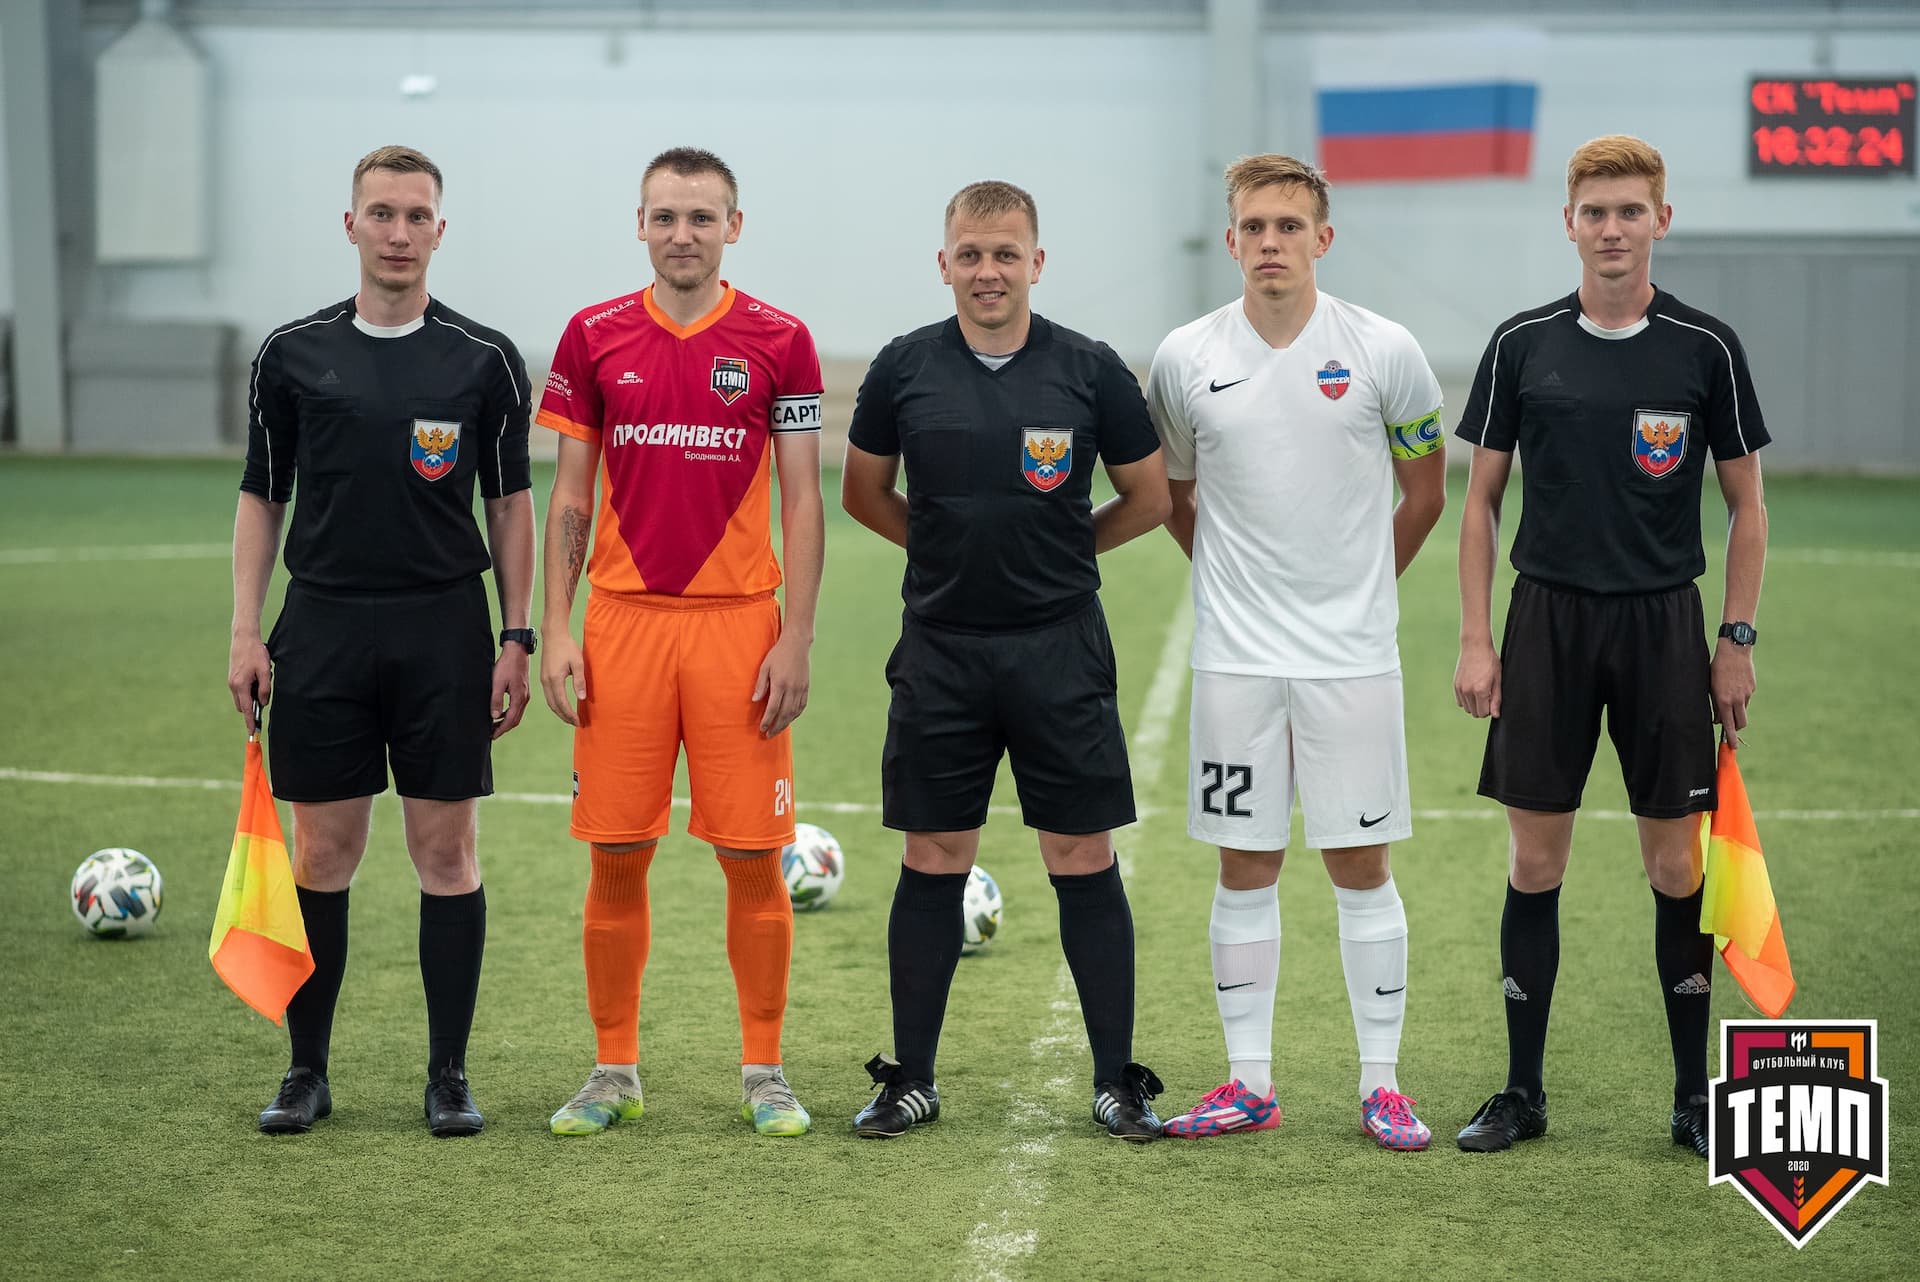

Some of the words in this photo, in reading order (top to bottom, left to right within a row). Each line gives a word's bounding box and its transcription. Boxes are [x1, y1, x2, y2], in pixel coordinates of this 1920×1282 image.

[715, 370, 746, 389] ТЕМП
[613, 423, 746, 449] ПРОДИНВЕСТ
[684, 450, 726, 462] Бродников
[1202, 760, 1254, 818] 22
